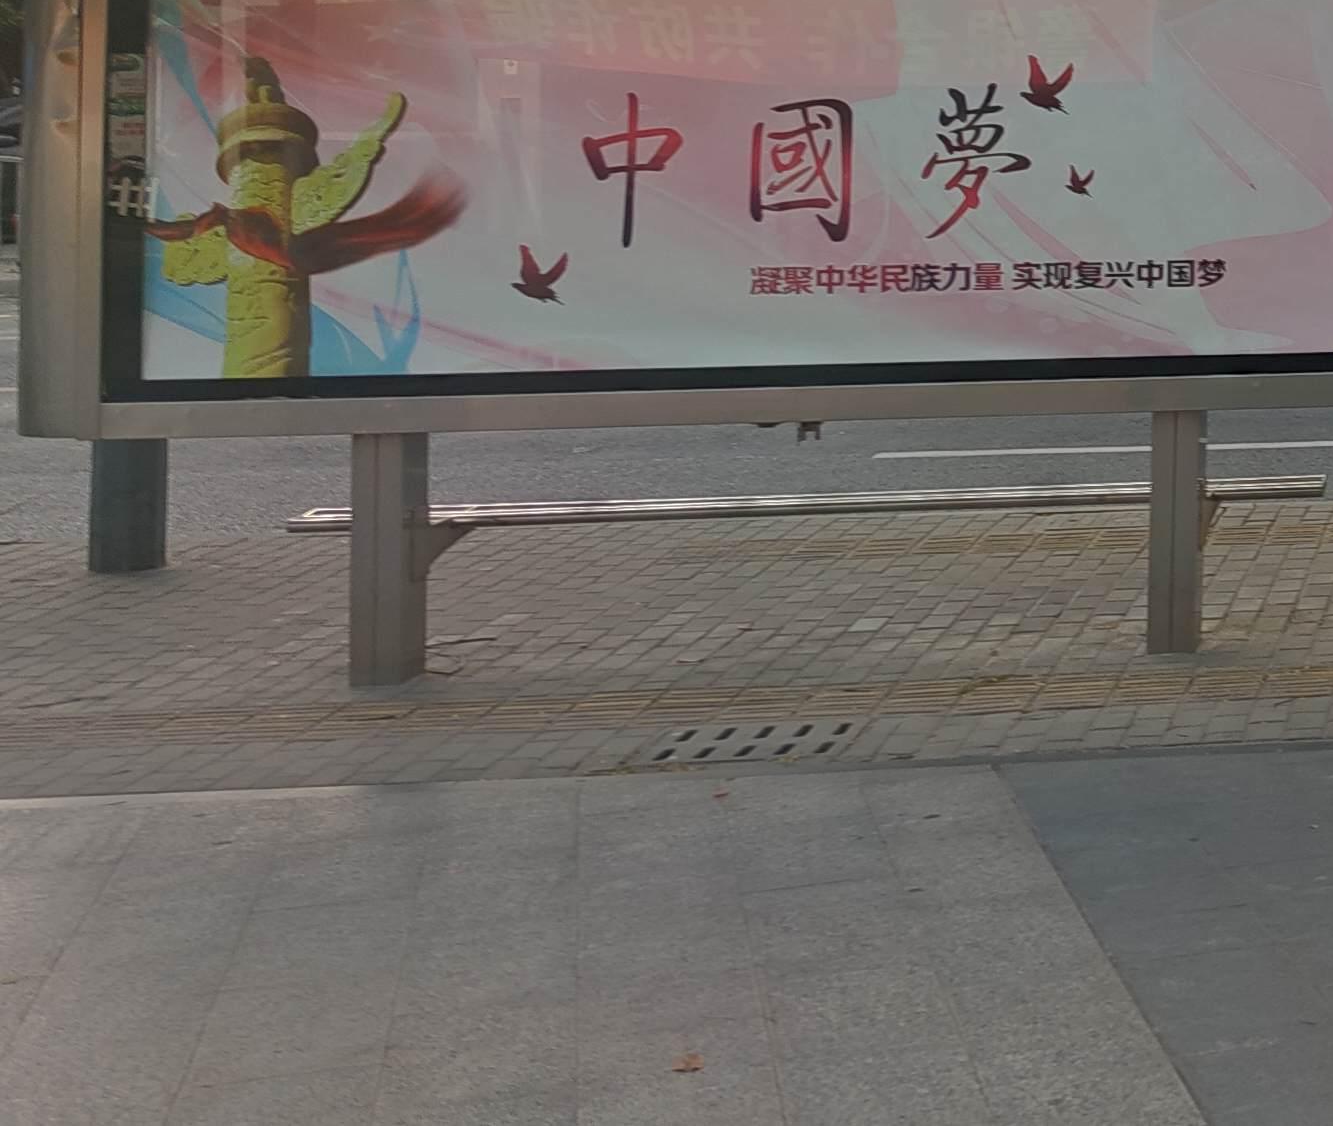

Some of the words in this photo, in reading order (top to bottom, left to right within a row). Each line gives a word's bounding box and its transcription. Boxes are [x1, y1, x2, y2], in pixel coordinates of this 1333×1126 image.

[582, 83, 1031, 248] 中國夢
[749, 261, 1005, 296] 凝聚中华民族力量
[1011, 259, 1227, 292] 实现复兴中国梦
